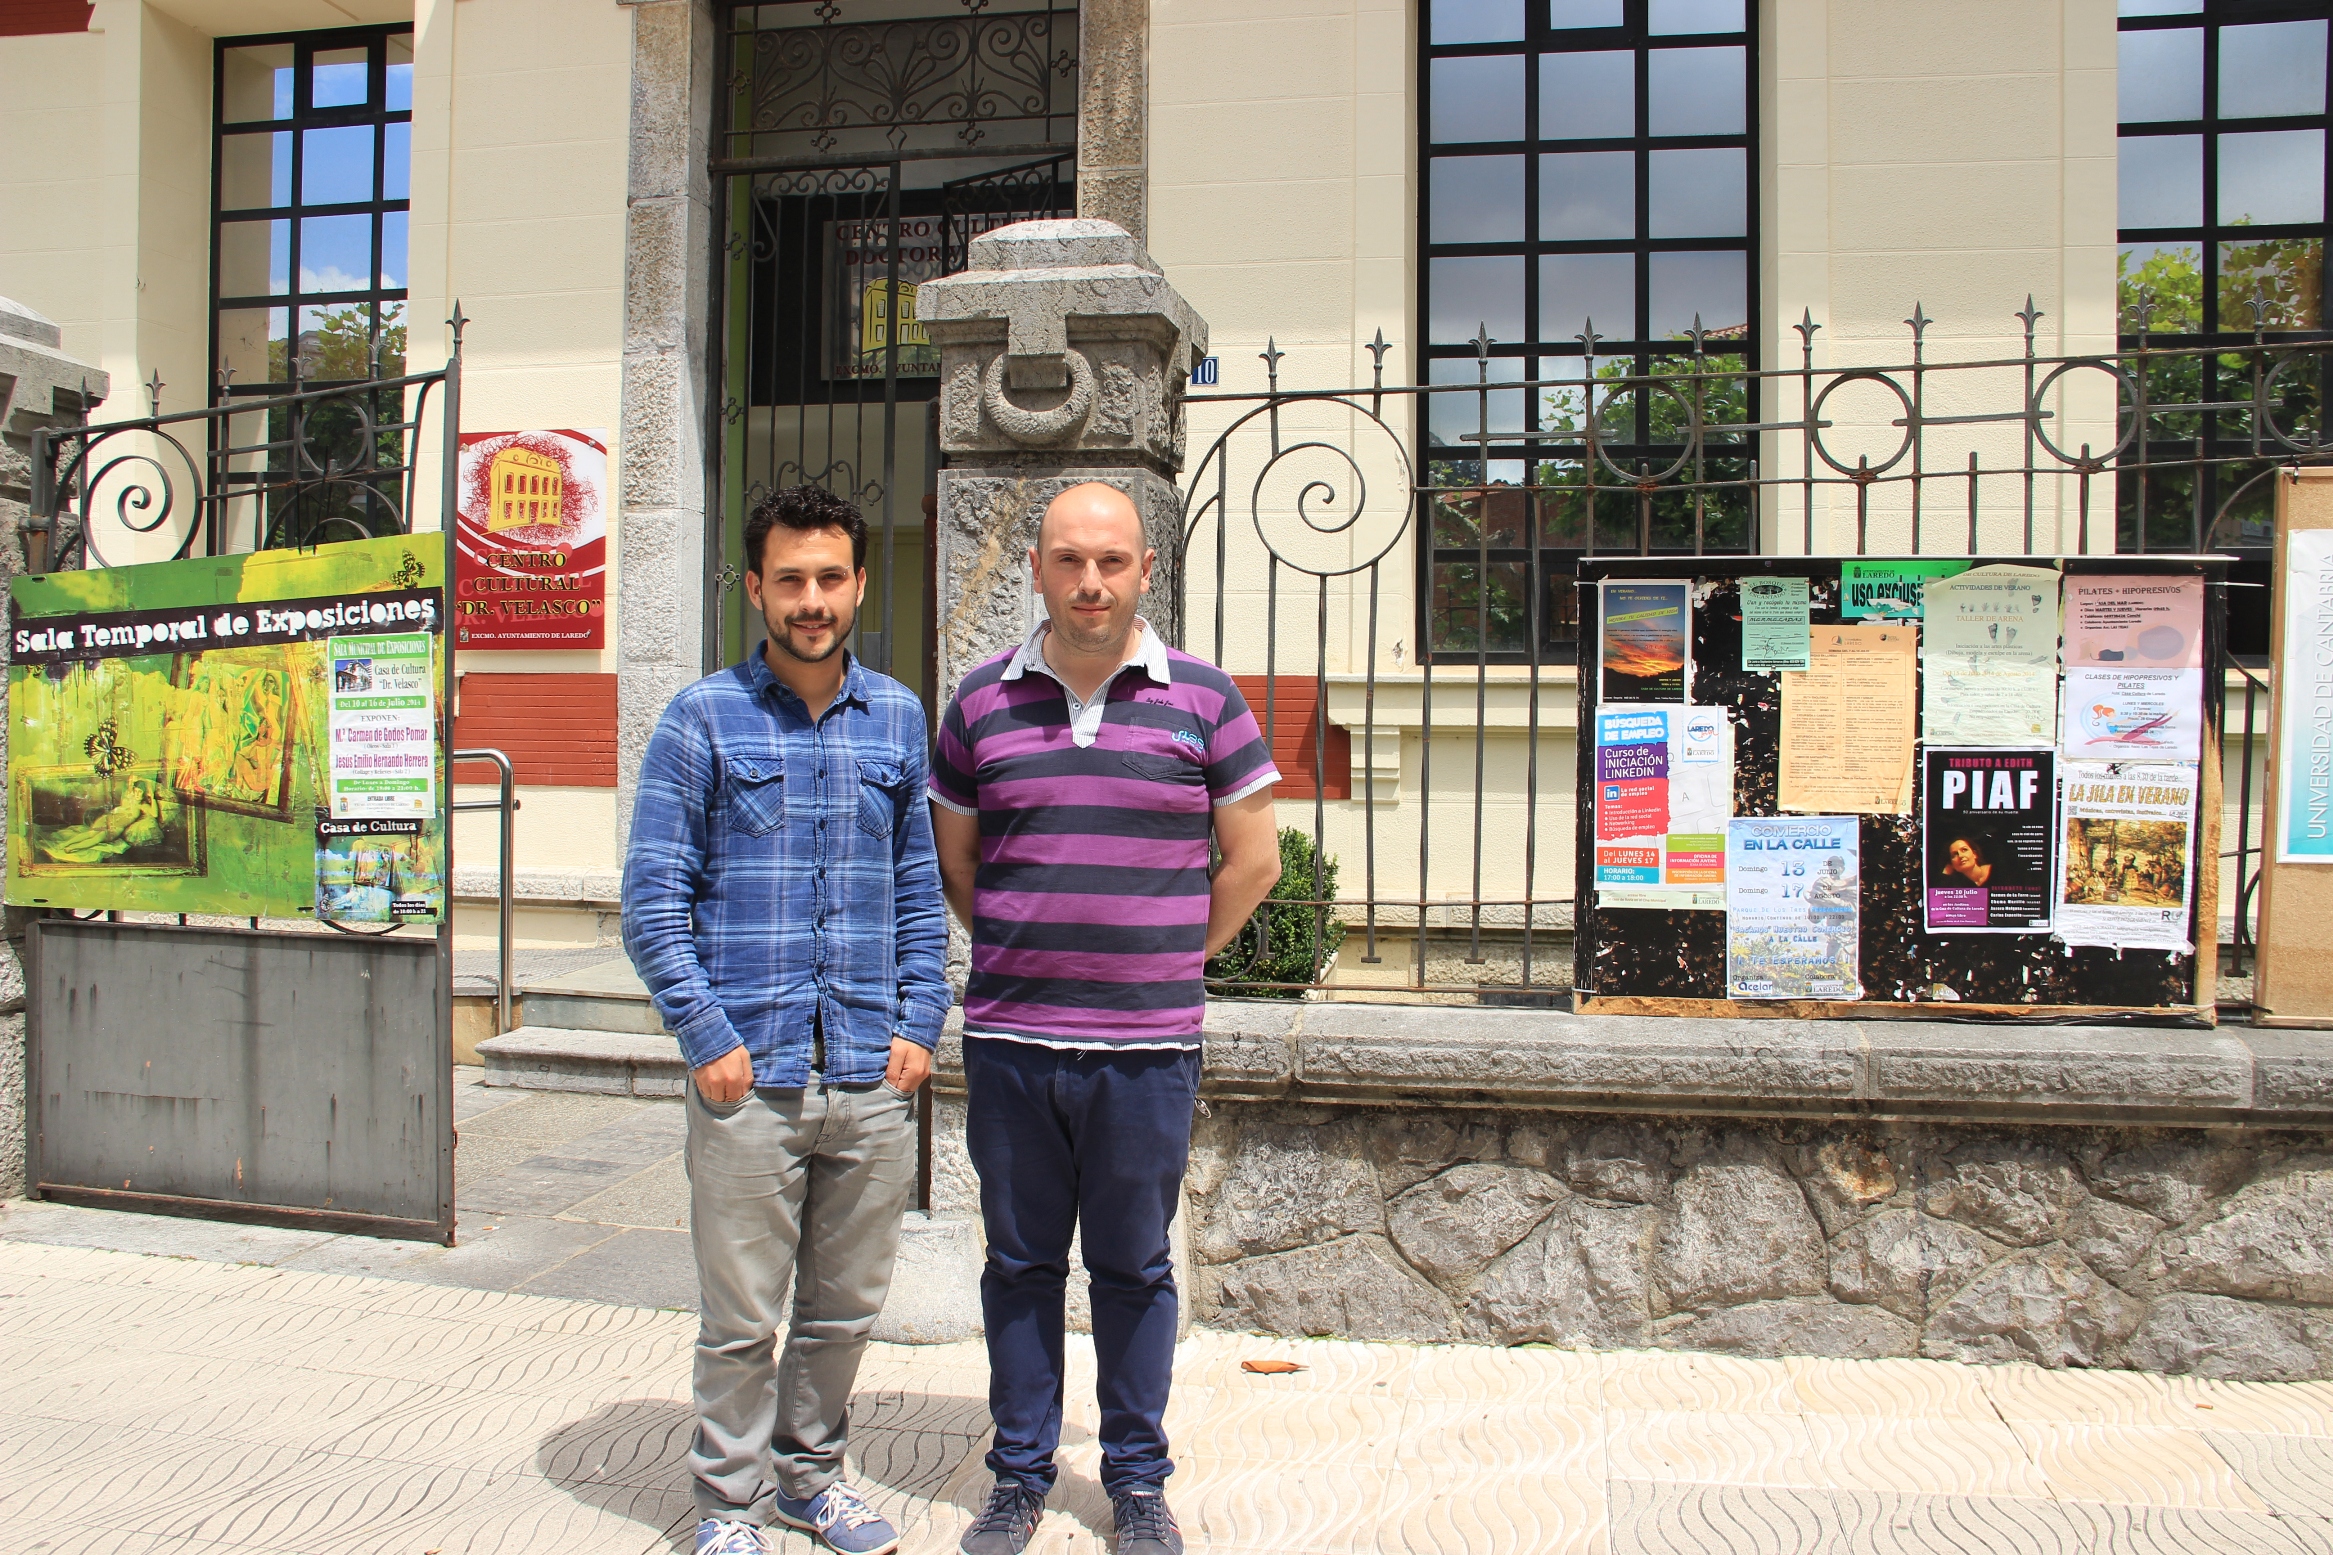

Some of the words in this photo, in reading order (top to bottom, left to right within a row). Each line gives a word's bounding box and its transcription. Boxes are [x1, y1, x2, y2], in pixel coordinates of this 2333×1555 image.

[1197, 360, 1214, 384] 10
[486, 552, 566, 568] CENTRO
[474, 576, 580, 592] CULTURAL
[1852, 583, 1874, 608] uso
[456, 600, 494, 615] “DR.
[500, 599, 601, 615] VELASCO”
[2316, 552, 2333, 667] CANTABRIA
[16, 628, 75, 653] Sala
[80, 615, 208, 649] Temporal
[213, 612, 250, 636] de
[256, 598, 436, 636] Exposiciones
[334, 643, 347, 656] SALA
[349, 642, 377, 656] MUNICIPAL
[377, 641, 386, 654] DE
[386, 640, 426, 654] EXPOSICIONES
[375, 665, 390, 675] Casa
[392, 664, 399, 674] de
[401, 663, 426, 674] Cultura
[379, 679, 392, 690] “Dr.
[394, 678, 422, 689] Velasco”
[2315, 672, 2333, 698] DE
[387, 698, 405, 708] Julio
[1604, 716, 1663, 730] BÚSQUEDA
[348, 728, 373, 742] Carmen
[374, 728, 382, 741] de
[384, 728, 404, 741] Godos
[406, 727, 428, 741] Pomar
[1604, 730, 1619, 741] DE
[1621, 728, 1665, 740] EMPLEO
[1605, 748, 1634, 758] Curso
[1637, 746, 1649, 756] de
[336, 754, 352, 768] Jesús
[354, 754, 372, 768] Emilio
[374, 754, 403, 768] Hernando
[404, 754, 428, 767] Herrera
[1605, 754, 1663, 768] INICIACIÓN
[1949, 758, 1992, 767] TRIBUTO
[1995, 758, 2001, 767] A
[2004, 758, 2033, 767] EDITH
[1605, 767, 1655, 778] LINKEDIN
[2078, 770, 2093, 778] Todos
[2307, 705, 2332, 838] UNIVERSIDAD
[1606, 789, 1617, 798] in
[1942, 770, 2038, 809] PIAF
[2069, 784, 2084, 802] LA
[2086, 784, 2114, 802] JILA
[2117, 785, 2135, 804] EN
[2138, 786, 2189, 806] VERANO
[320, 823, 350, 833] Casa
[352, 822, 368, 832] de
[370, 820, 417, 831] Cultura
[1752, 825, 1832, 837] COMERCIO
[1744, 840, 1762, 850] EN
[1767, 839, 1788, 850] LA
[1792, 838, 1841, 849] CALLE
[1782, 883, 1804, 898] 17
[1773, 956, 1836, 964] ESPERAMOS
[1739, 982, 1772, 990] acelar
